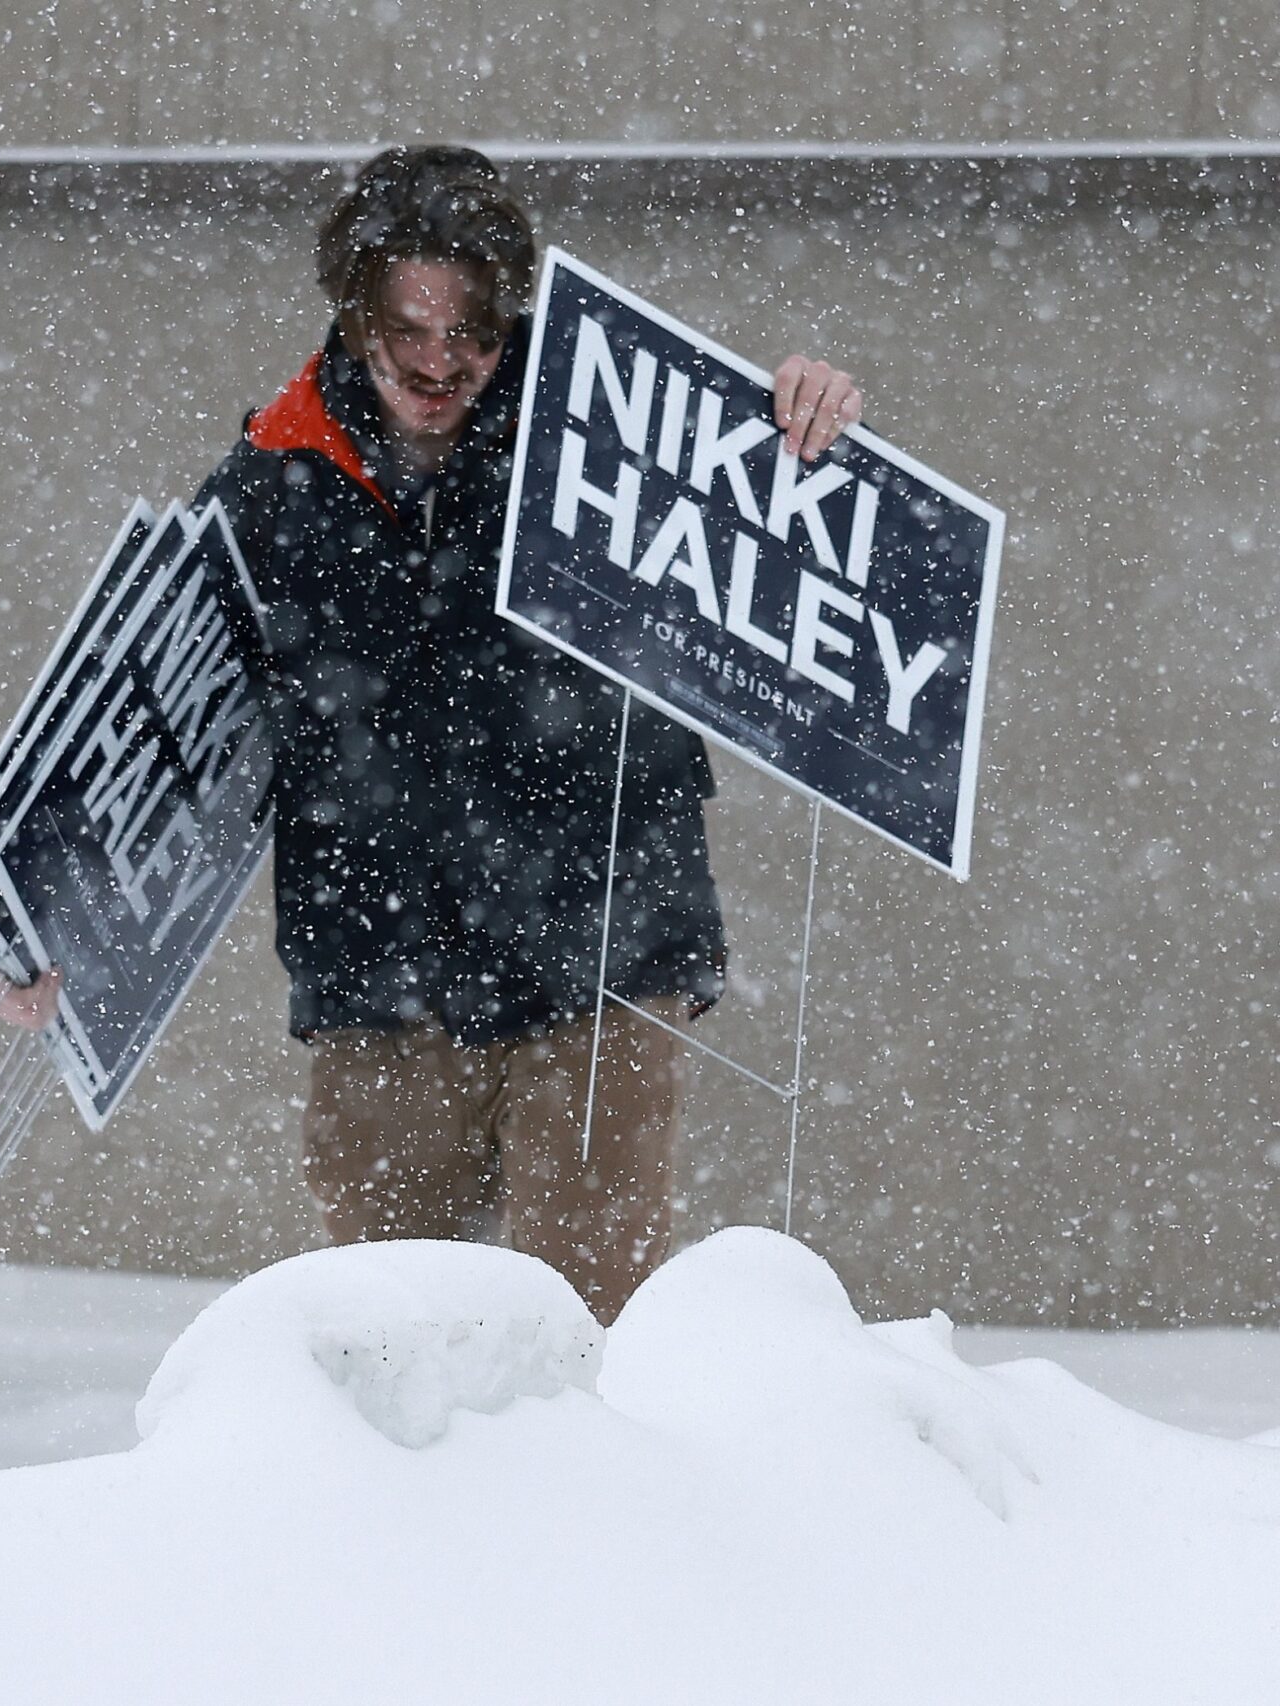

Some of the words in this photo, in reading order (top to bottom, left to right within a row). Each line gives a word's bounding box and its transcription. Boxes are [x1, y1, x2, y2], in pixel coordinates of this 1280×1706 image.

[551, 428, 948, 734] HALEY
[567, 314, 880, 588] NIKKI
[642, 613, 686, 652] FOR
[695, 644, 815, 726] PRESIDENT
[70, 676, 219, 951] HALEY
